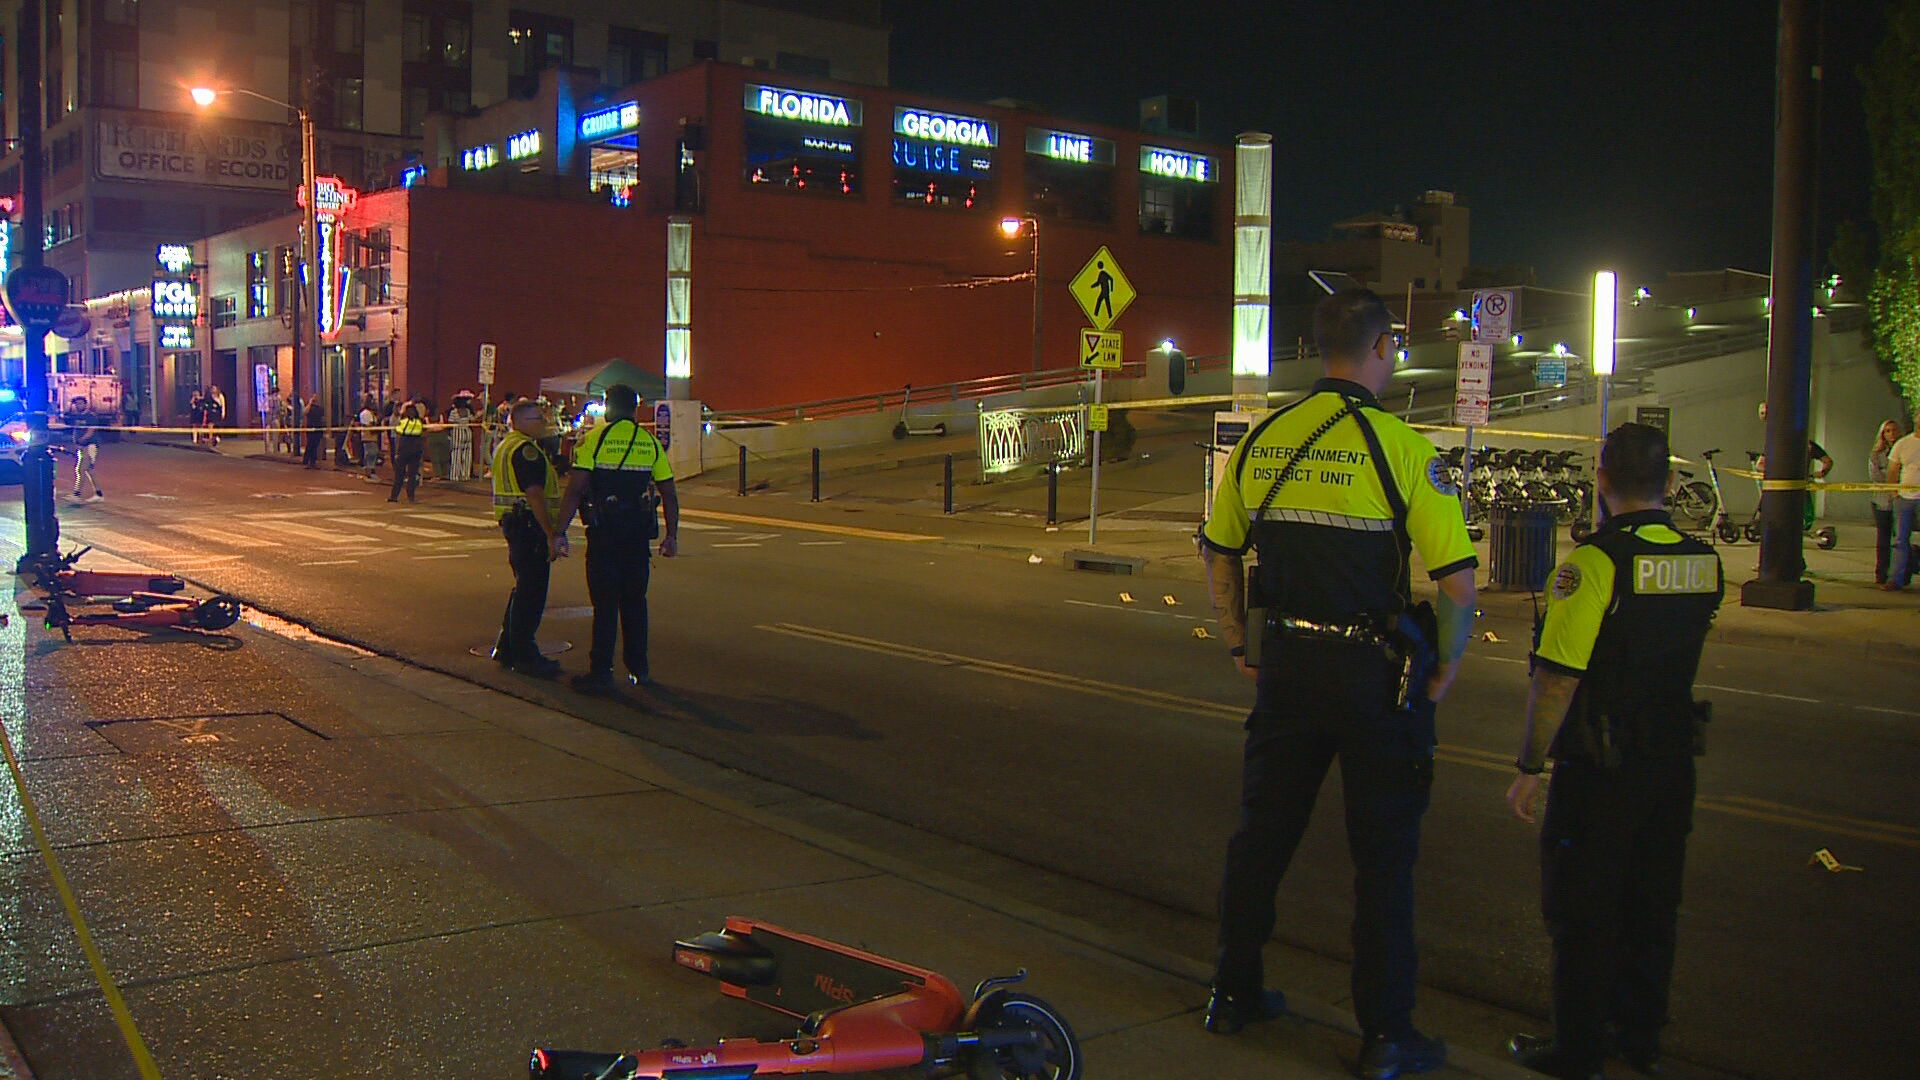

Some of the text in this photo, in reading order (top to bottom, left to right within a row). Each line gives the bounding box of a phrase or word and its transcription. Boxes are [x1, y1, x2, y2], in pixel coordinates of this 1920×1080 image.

[761, 89, 849, 126] FLORIDA
[903, 112, 990, 146] GEORGIA
[1050, 136, 1090, 163] LINE
[118, 151, 195, 173] OFFICE
[317, 212, 335, 223] AND
[155, 282, 196, 304] FGL
[1101, 339, 1119, 349] STATE
[1103, 351, 1116, 362] LAW
[1461, 361, 1489, 370] VENDING
[1251, 446, 1369, 466] ENTERAINMENT
[1320, 470, 1355, 487] UNIT
